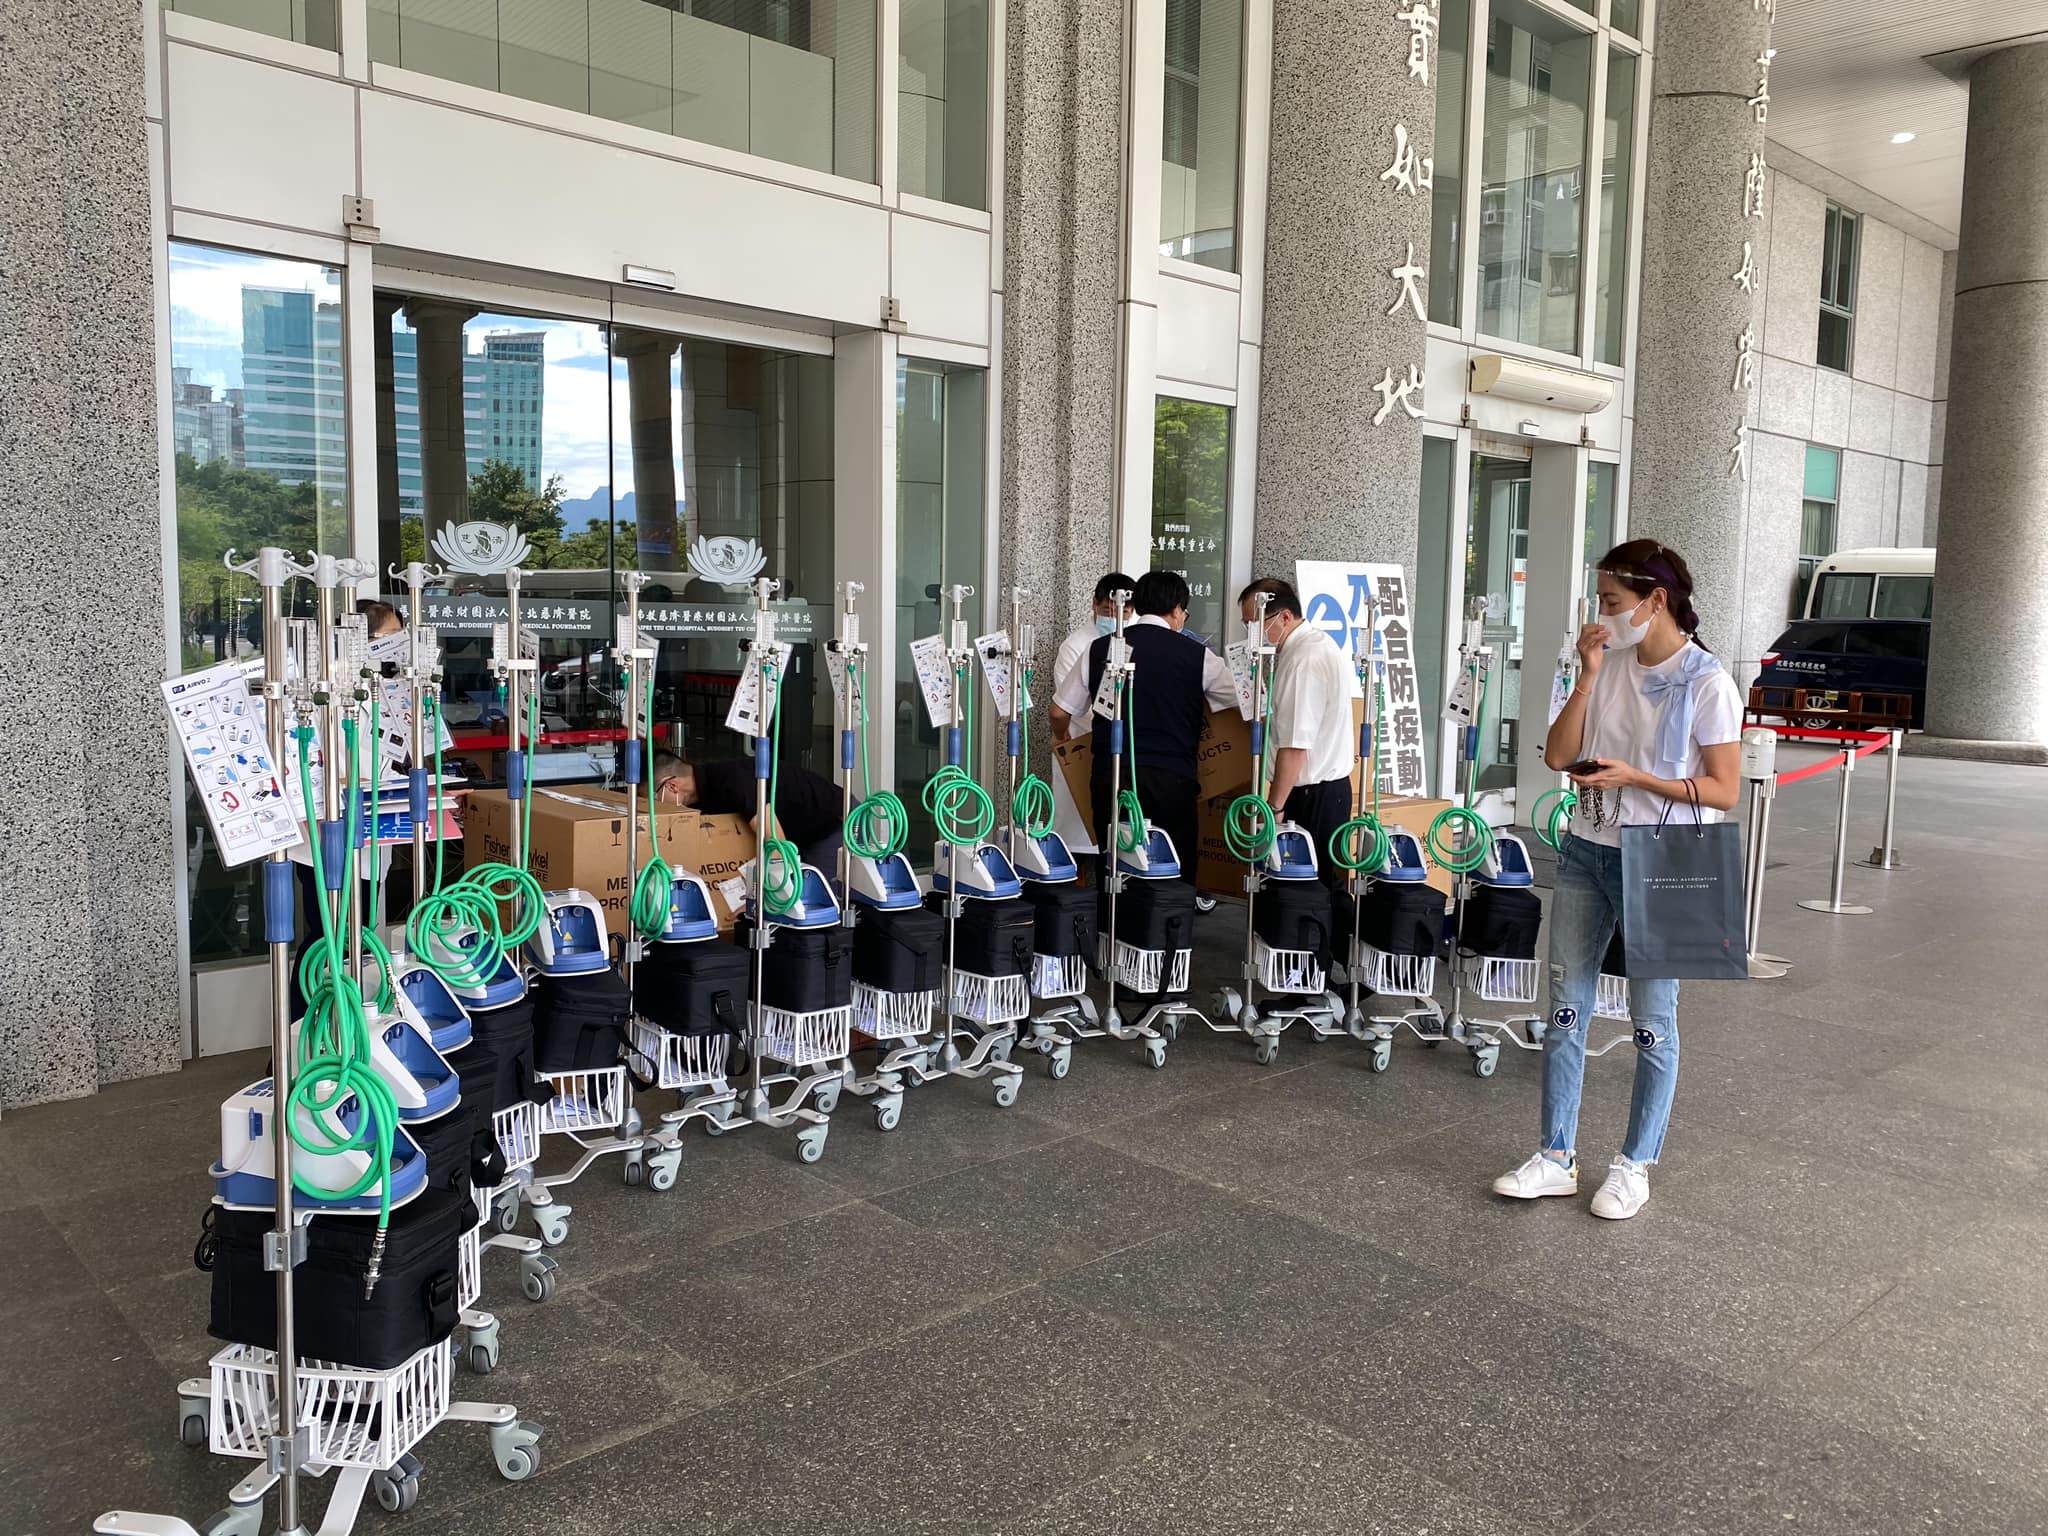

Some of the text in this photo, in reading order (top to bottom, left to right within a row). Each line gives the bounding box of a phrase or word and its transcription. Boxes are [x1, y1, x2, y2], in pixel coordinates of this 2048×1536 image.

[1371, 0, 1439, 427] 貴如大地
[552, 623, 592, 631] FOUNDATION
[1377, 576, 1423, 798] 配合防疫動
[484, 834, 511, 857] Fisher
[698, 860, 749, 876] MEDIC
